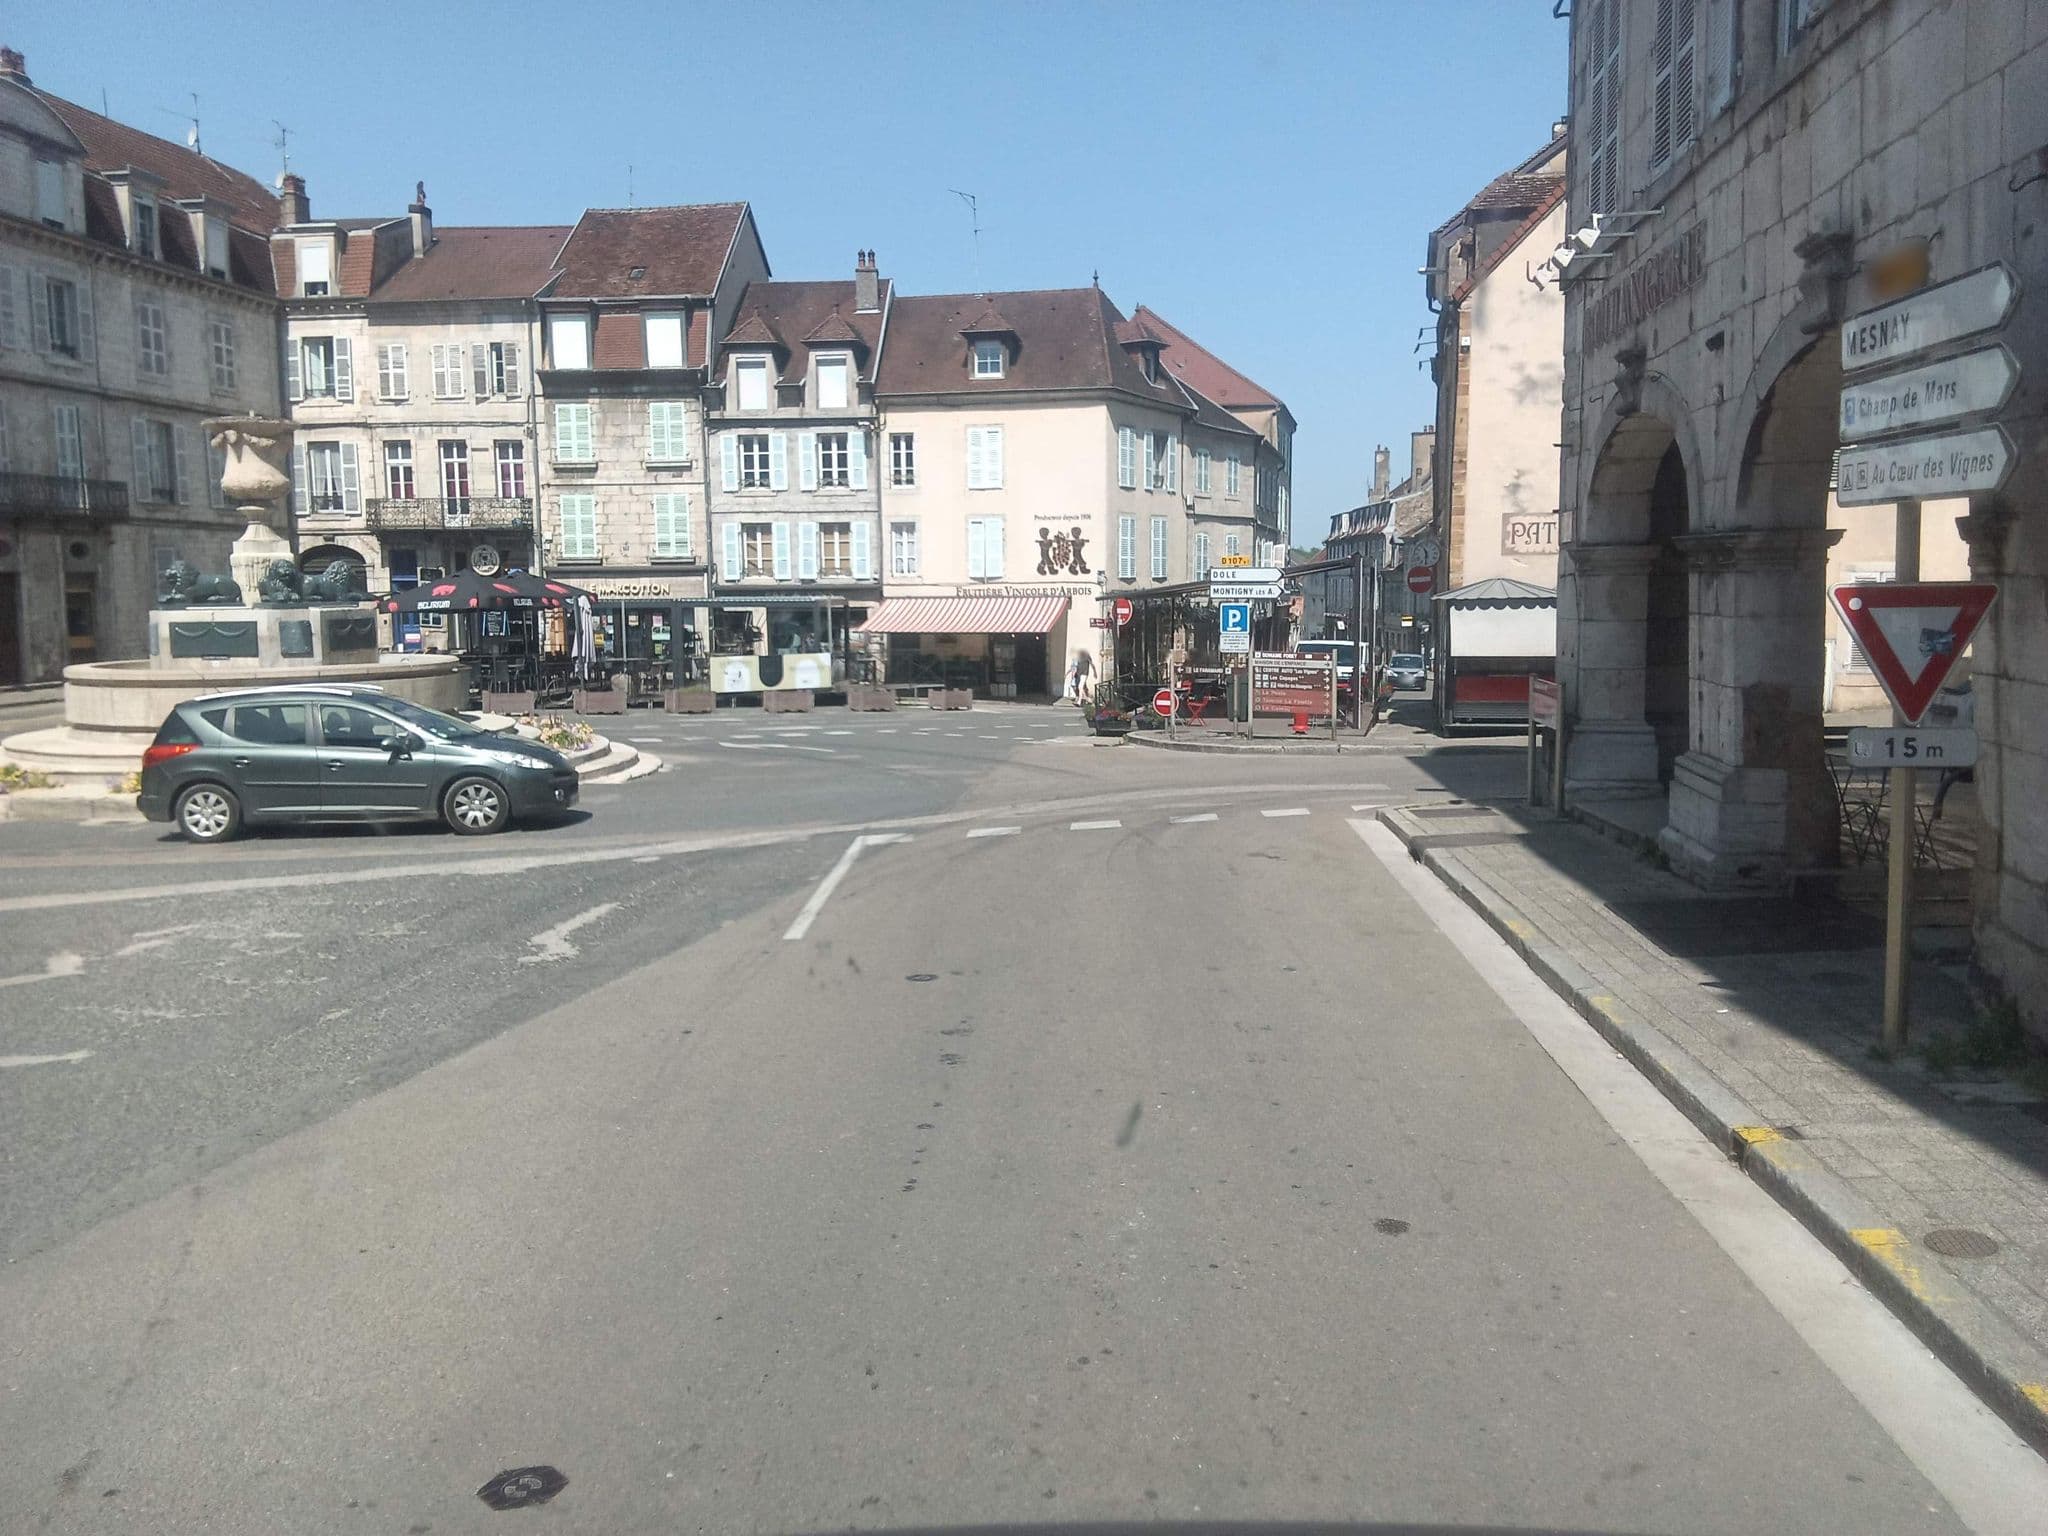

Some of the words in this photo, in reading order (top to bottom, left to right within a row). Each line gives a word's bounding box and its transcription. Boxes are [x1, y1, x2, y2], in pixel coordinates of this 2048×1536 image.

[1847, 312, 1910, 356] MESNAY
[1859, 396, 1897, 418] Champ
[1903, 388, 1918, 409] de
[1925, 381, 1957, 407] Mars
[1872, 464, 1885, 484] Au
[1923, 455, 1944, 479] des
[1950, 452, 1994, 483] Vignes
[1213, 571, 1237, 579] DOLE
[1005, 586, 1047, 597] VINICOLE
[1051, 585, 1092, 597] D'ARBOIS
[1213, 587, 1254, 595] MONTIGNY
[1228, 609, 1241, 628] P
[1885, 737, 1918, 758] 15
[1926, 744, 1943, 758] m
